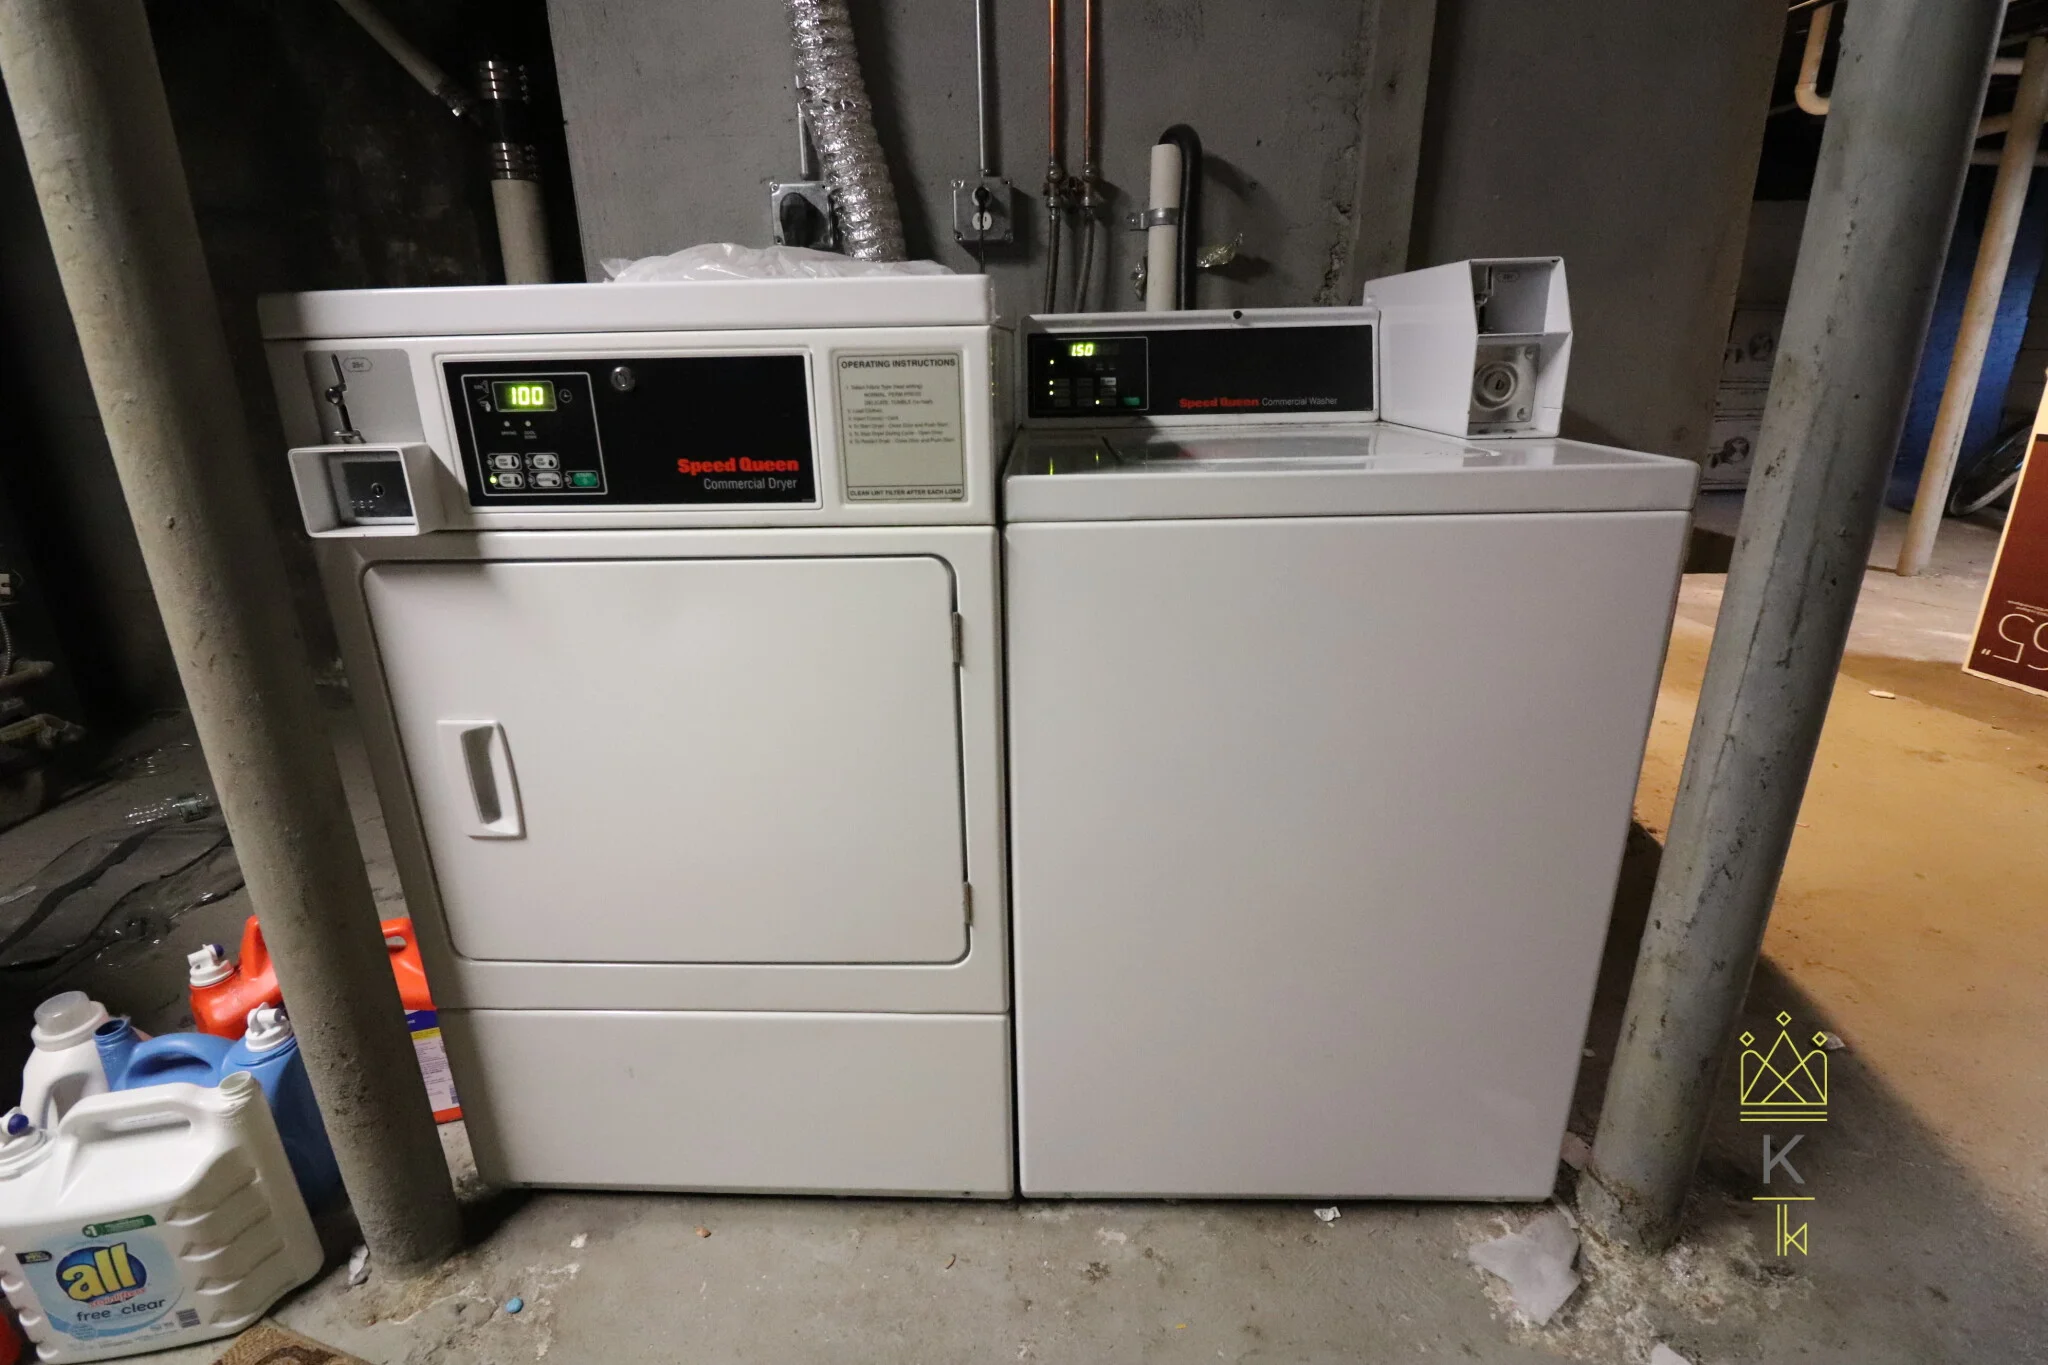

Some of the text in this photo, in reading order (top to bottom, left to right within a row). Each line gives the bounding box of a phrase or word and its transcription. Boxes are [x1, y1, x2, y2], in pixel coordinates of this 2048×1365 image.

[841, 358, 956, 369] OPERATING INSTRUCTIONS
[1179, 396, 1338, 409] Speed Queen Commercial Washer
[677, 456, 800, 476] Speed Queen
[703, 477, 798, 491] Commercial Dryer
[61, 1242, 138, 1301] all
[77, 1309, 111, 1322] free
[121, 1298, 166, 1315] clear
